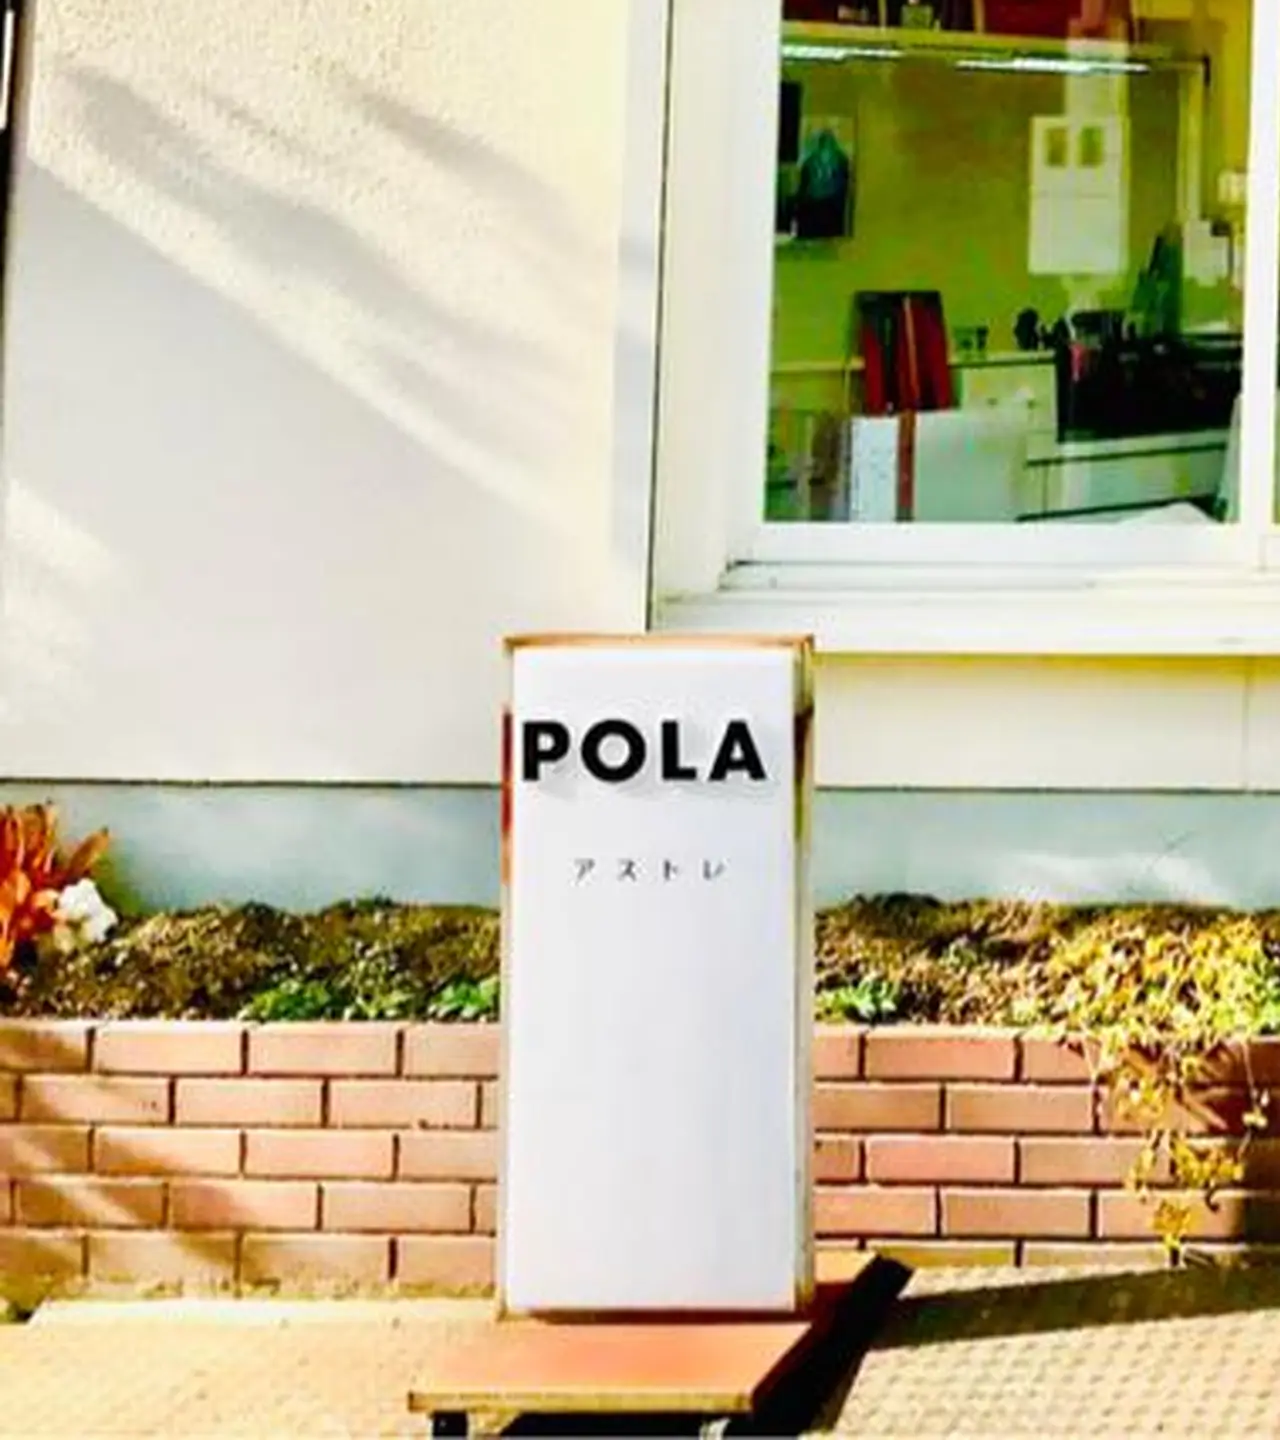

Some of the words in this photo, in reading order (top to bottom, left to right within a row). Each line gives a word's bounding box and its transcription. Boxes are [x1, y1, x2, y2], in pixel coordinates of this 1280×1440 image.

[521, 718, 768, 783] POLA
[573, 858, 726, 882] アストレ
